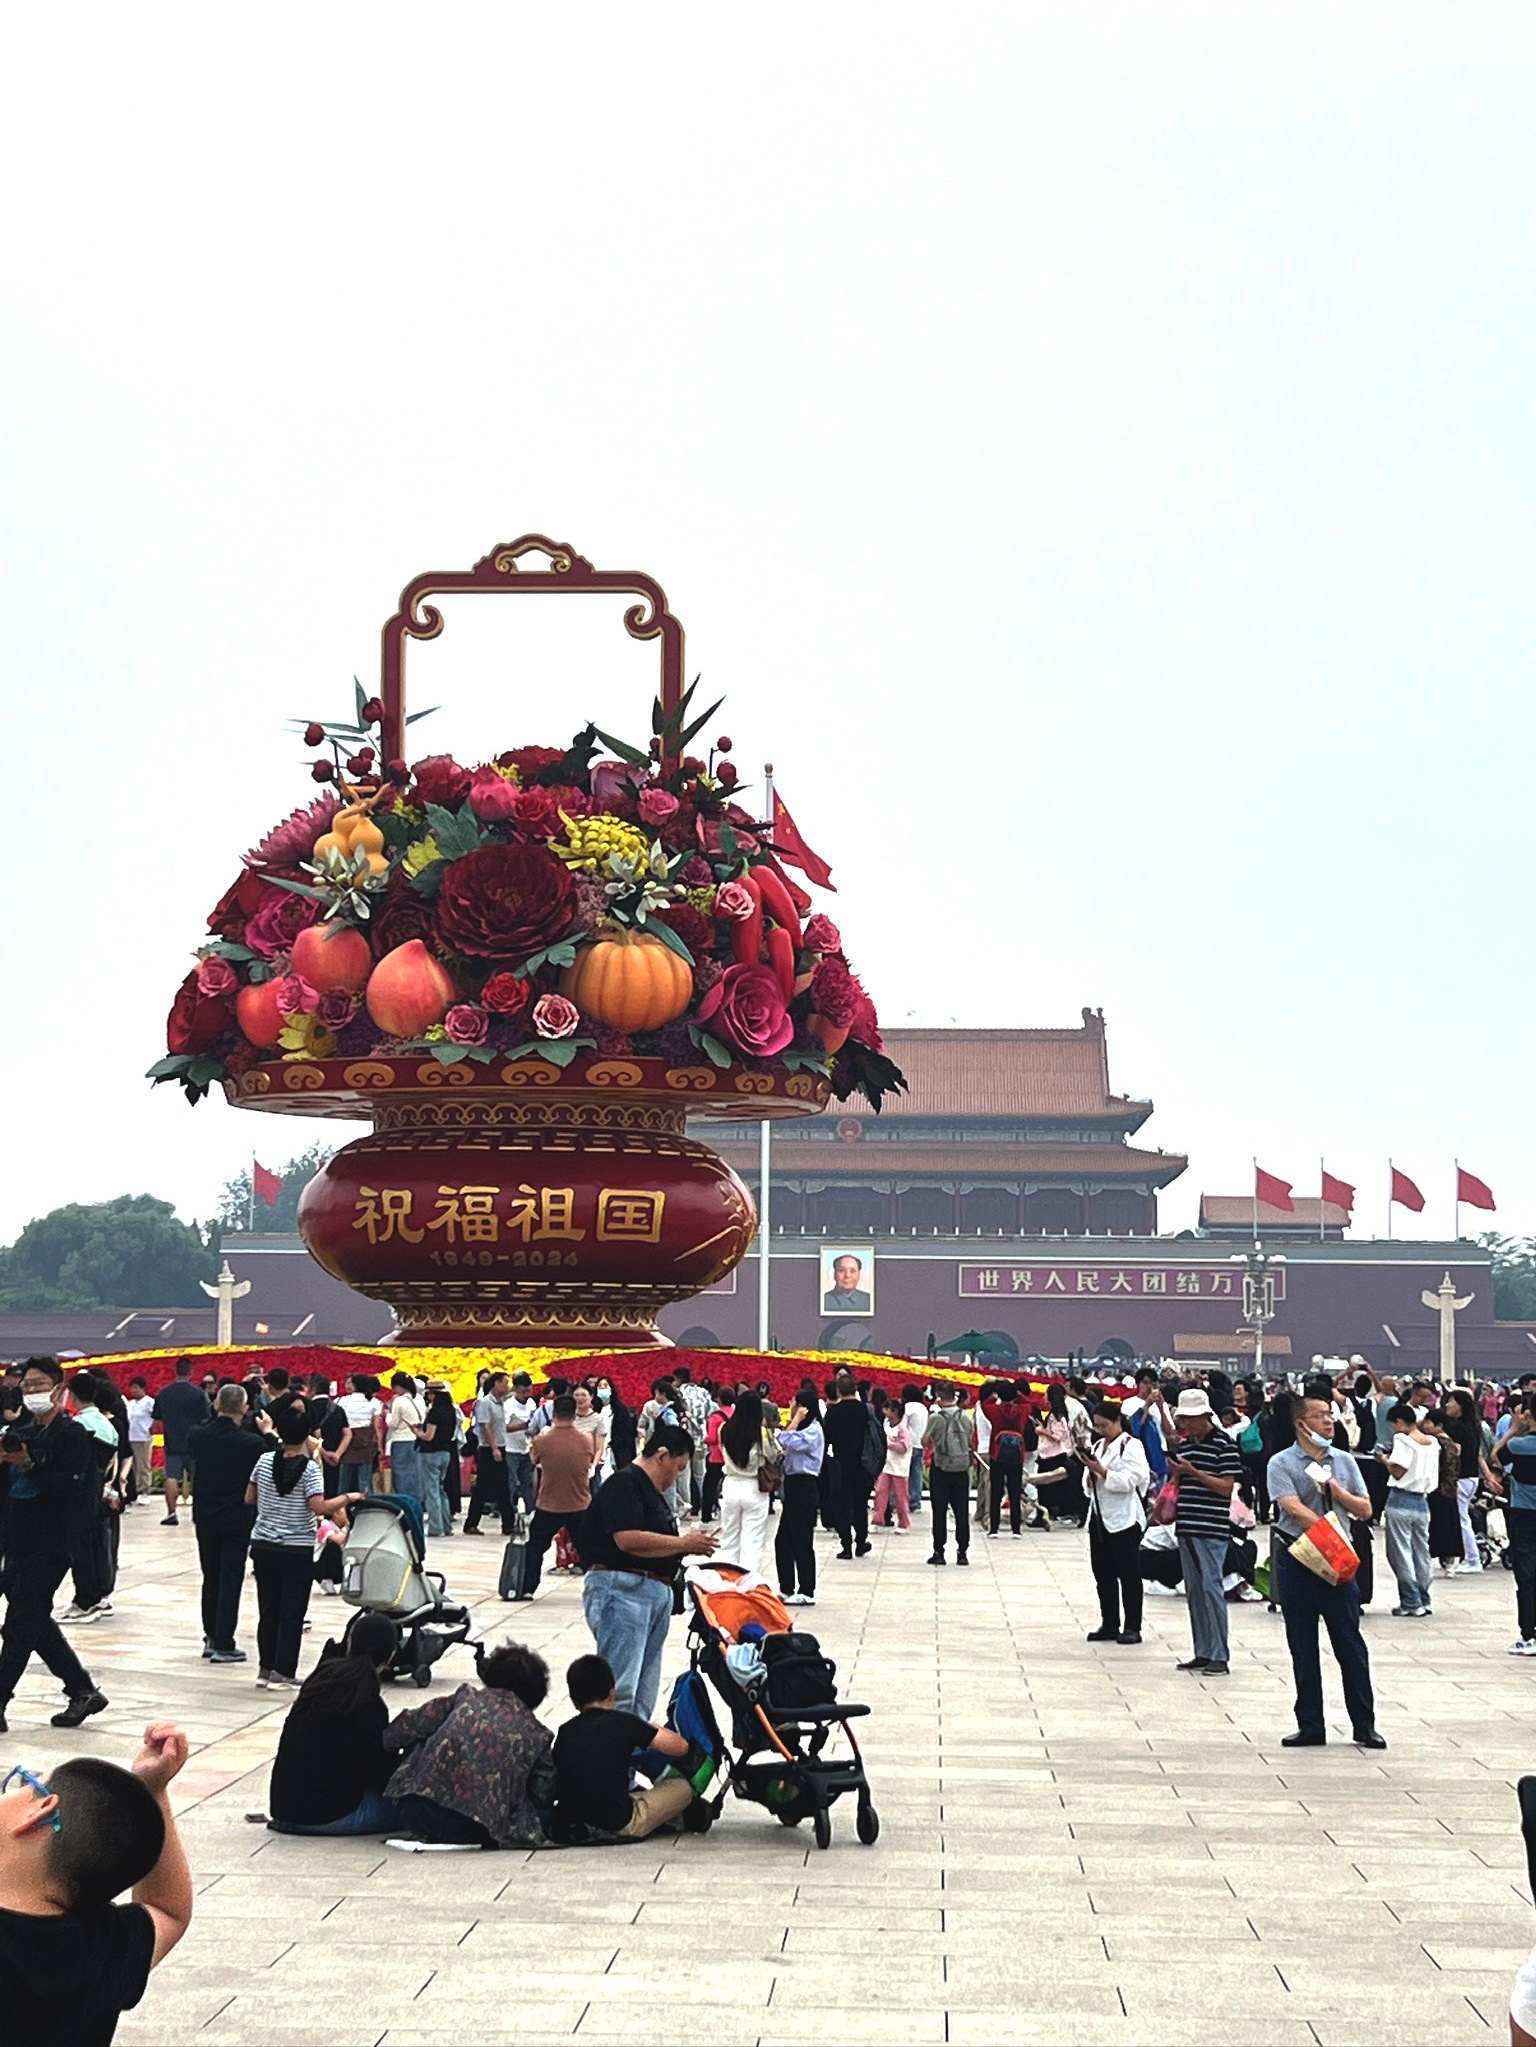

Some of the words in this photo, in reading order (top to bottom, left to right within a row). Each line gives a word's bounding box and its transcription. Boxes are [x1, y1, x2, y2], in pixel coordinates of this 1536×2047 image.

[352, 1184, 665, 1244] 祝福祖国
[430, 1250, 578, 1267] 1949-2024
[977, 1270, 1268, 1293] 世界人民大团结万
